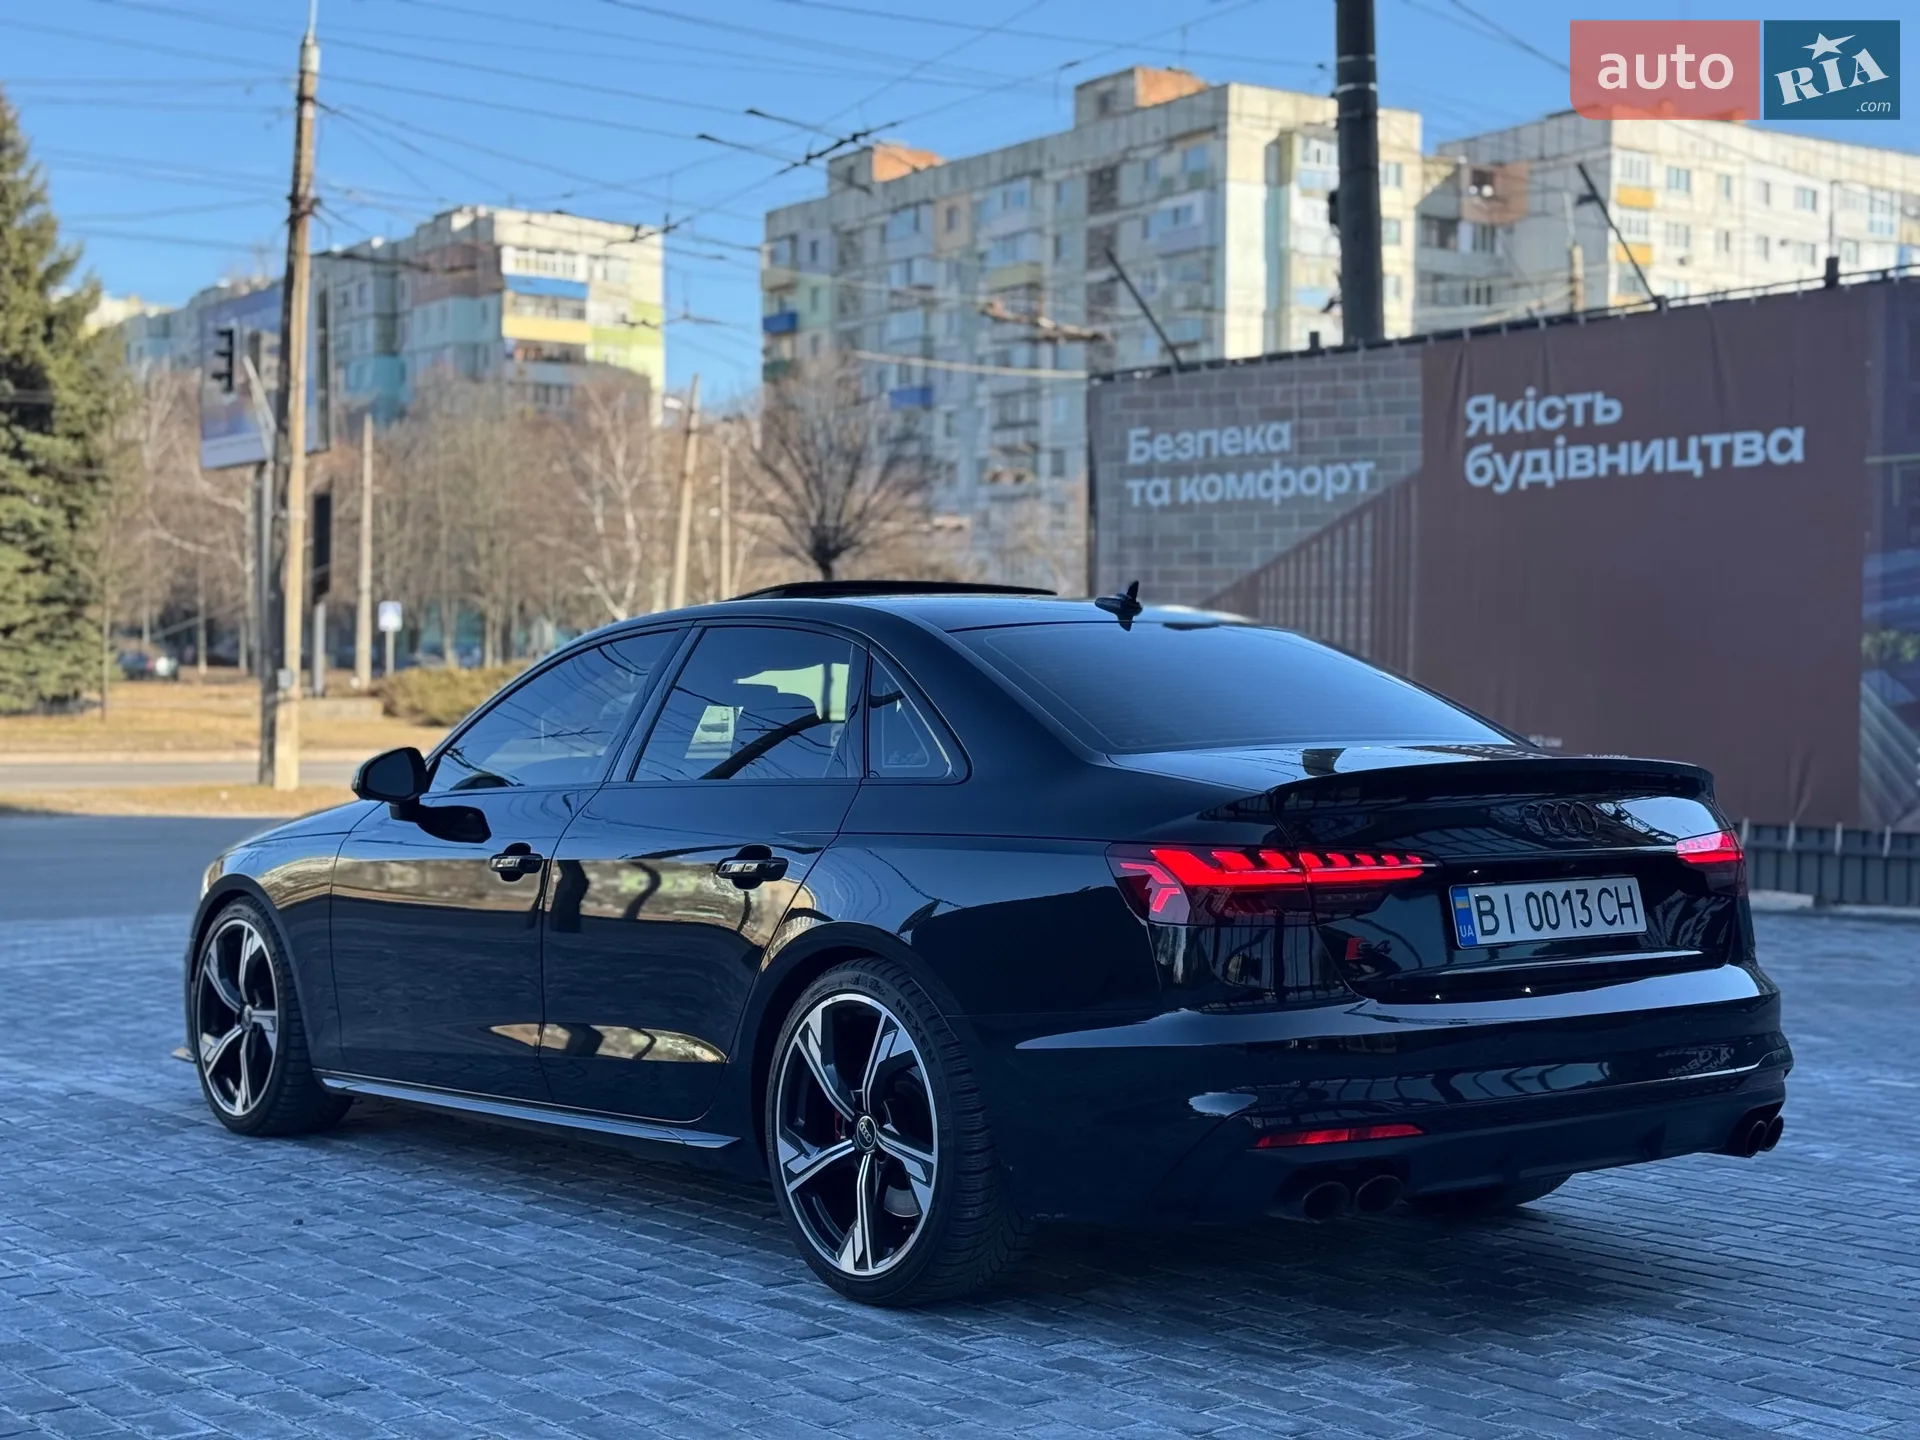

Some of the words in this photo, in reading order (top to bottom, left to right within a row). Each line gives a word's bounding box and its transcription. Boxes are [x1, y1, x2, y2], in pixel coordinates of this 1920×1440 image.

[1464, 386, 1623, 439] Якість
[1126, 419, 1293, 467] Безпека
[1464, 425, 1806, 495] будівництва
[1126, 475, 1172, 508] та
[1178, 457, 1376, 506] комфорт
[1459, 924, 1475, 939] UA
[1474, 894, 1515, 937] BI
[1524, 888, 1593, 932] 0013
[1597, 885, 1639, 927] CH
[895, 998, 936, 1064] NEXEN
